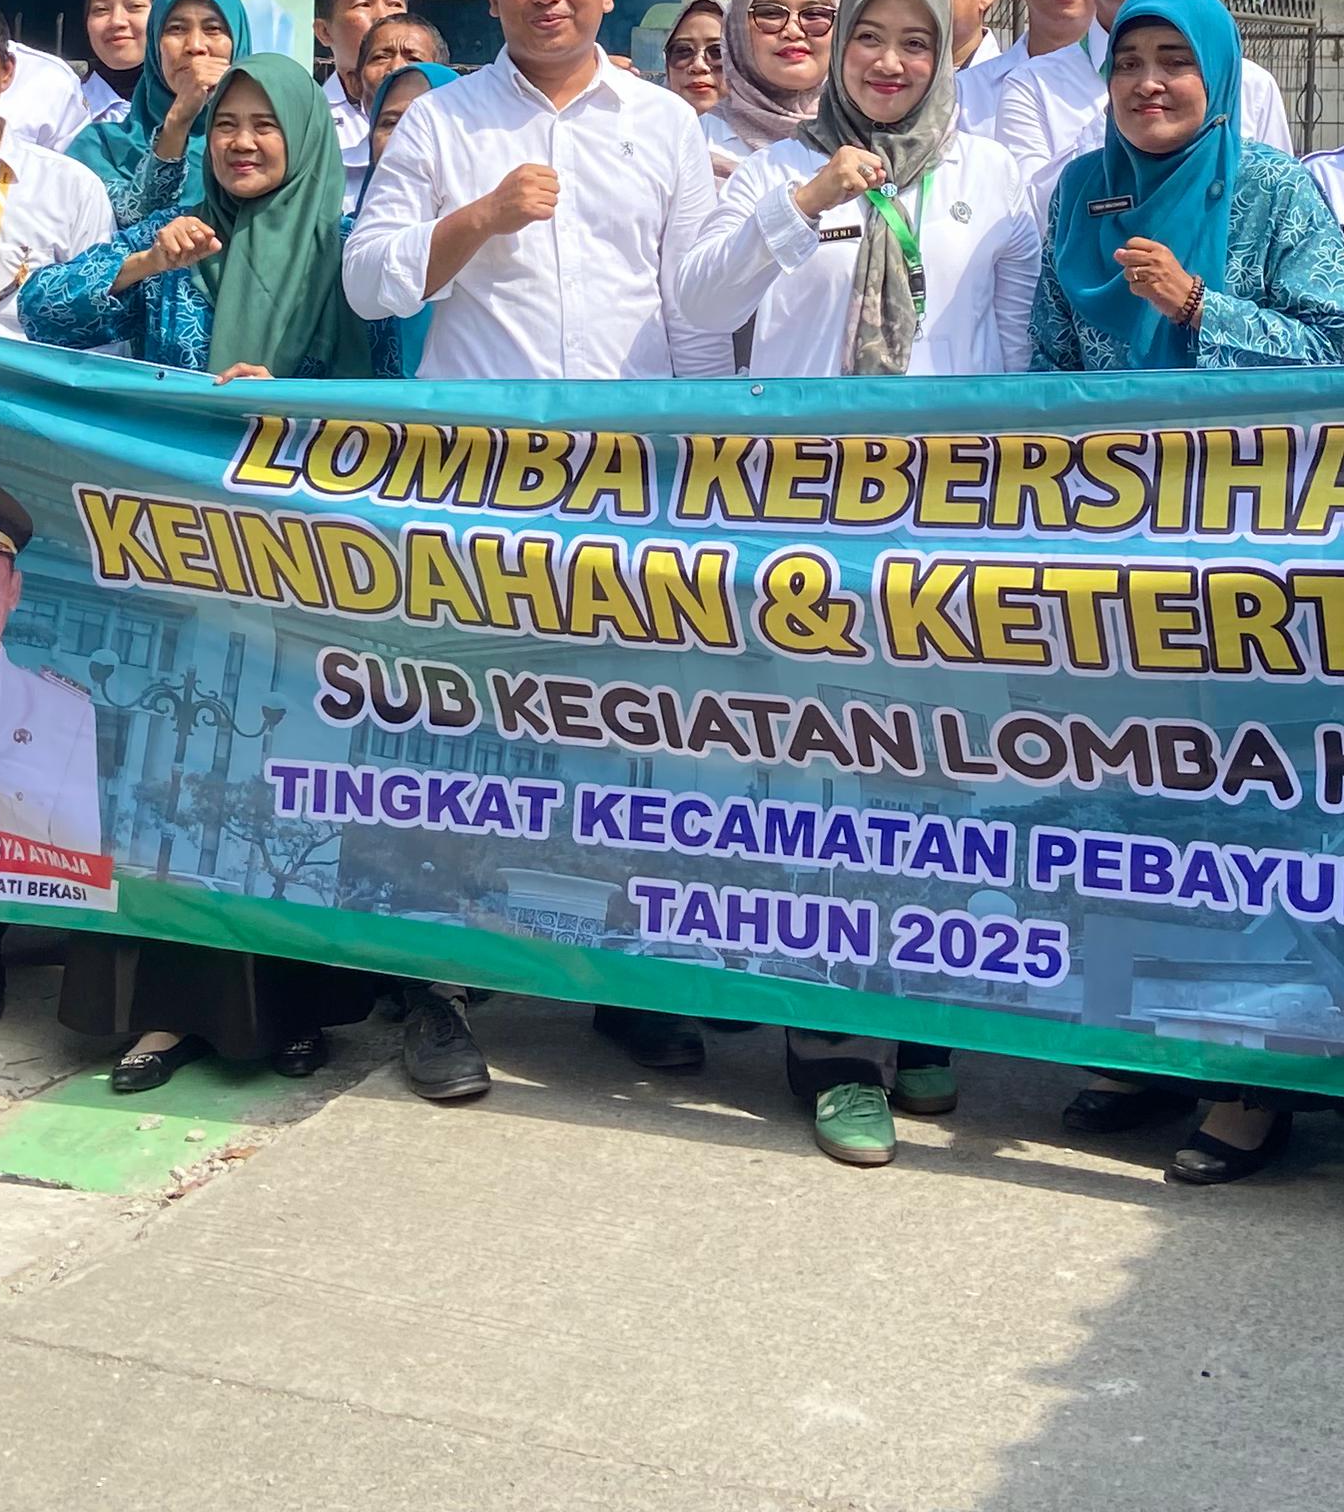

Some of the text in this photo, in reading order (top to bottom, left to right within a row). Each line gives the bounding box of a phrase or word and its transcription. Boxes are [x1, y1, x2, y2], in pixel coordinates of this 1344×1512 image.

[231, 416, 651, 518] LOMBA
[80, 489, 740, 650] KEINDAHAN
[758, 551, 863, 659] &
[321, 652, 477, 728] SUB
[492, 674, 919, 772] KEGIATAN
[939, 713, 1295, 803] LOMBA
[28, 844, 93, 879] ATMAJA
[270, 765, 558, 834] TINGKAT
[579, 790, 1009, 880] KECAMATAN
[25, 879, 88, 902] BEKASI
[635, 884, 1064, 981] TAHUN 2025
